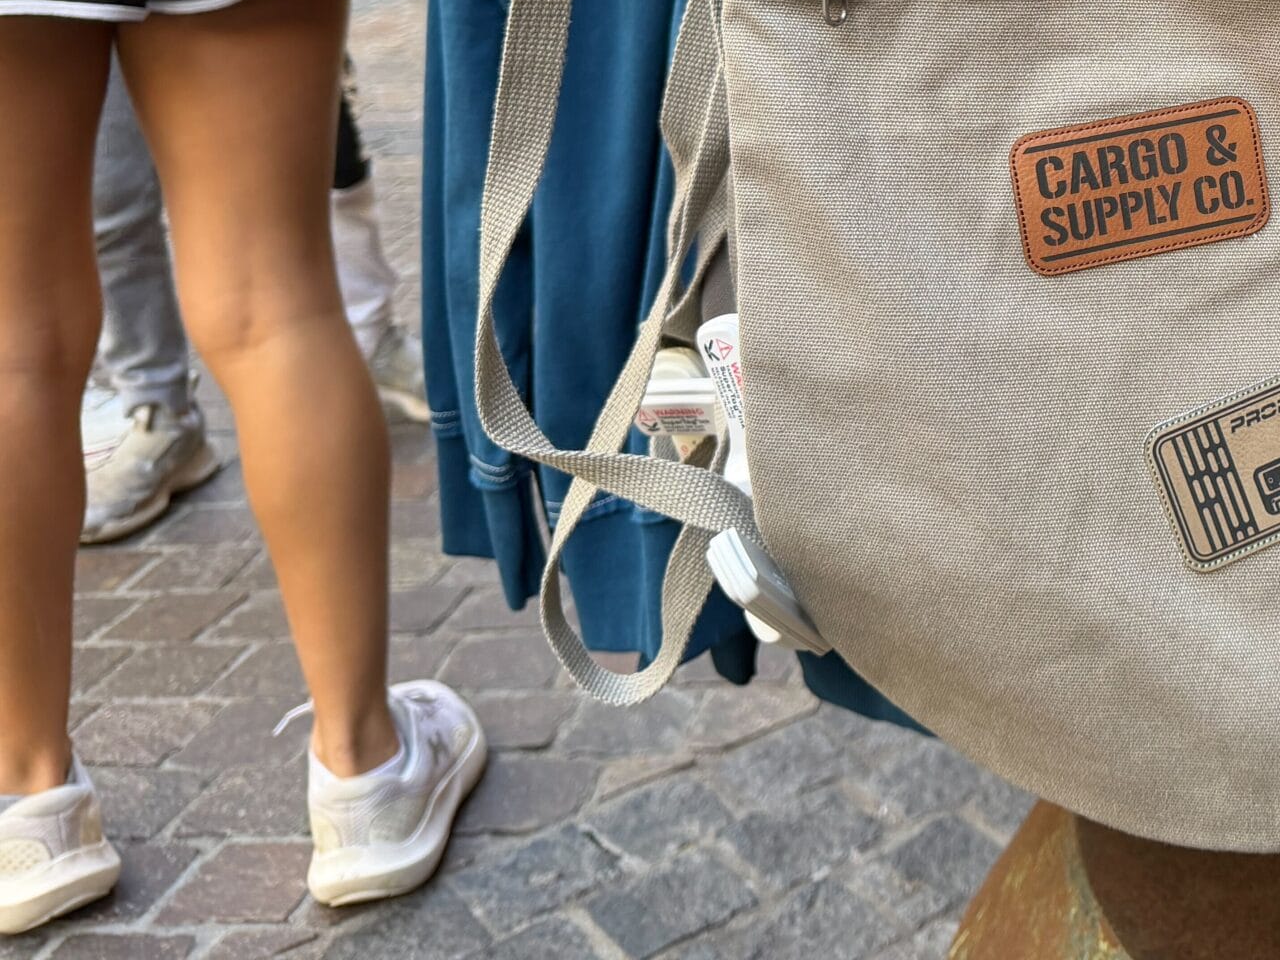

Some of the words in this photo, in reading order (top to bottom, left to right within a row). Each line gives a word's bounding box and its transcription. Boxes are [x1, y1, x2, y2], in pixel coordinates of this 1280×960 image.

[1035, 132, 1188, 200] CARGO
[1205, 124, 1237, 167] &
[1040, 181, 1182, 246] SUPPLY
[1193, 170, 1255, 215] CO.
